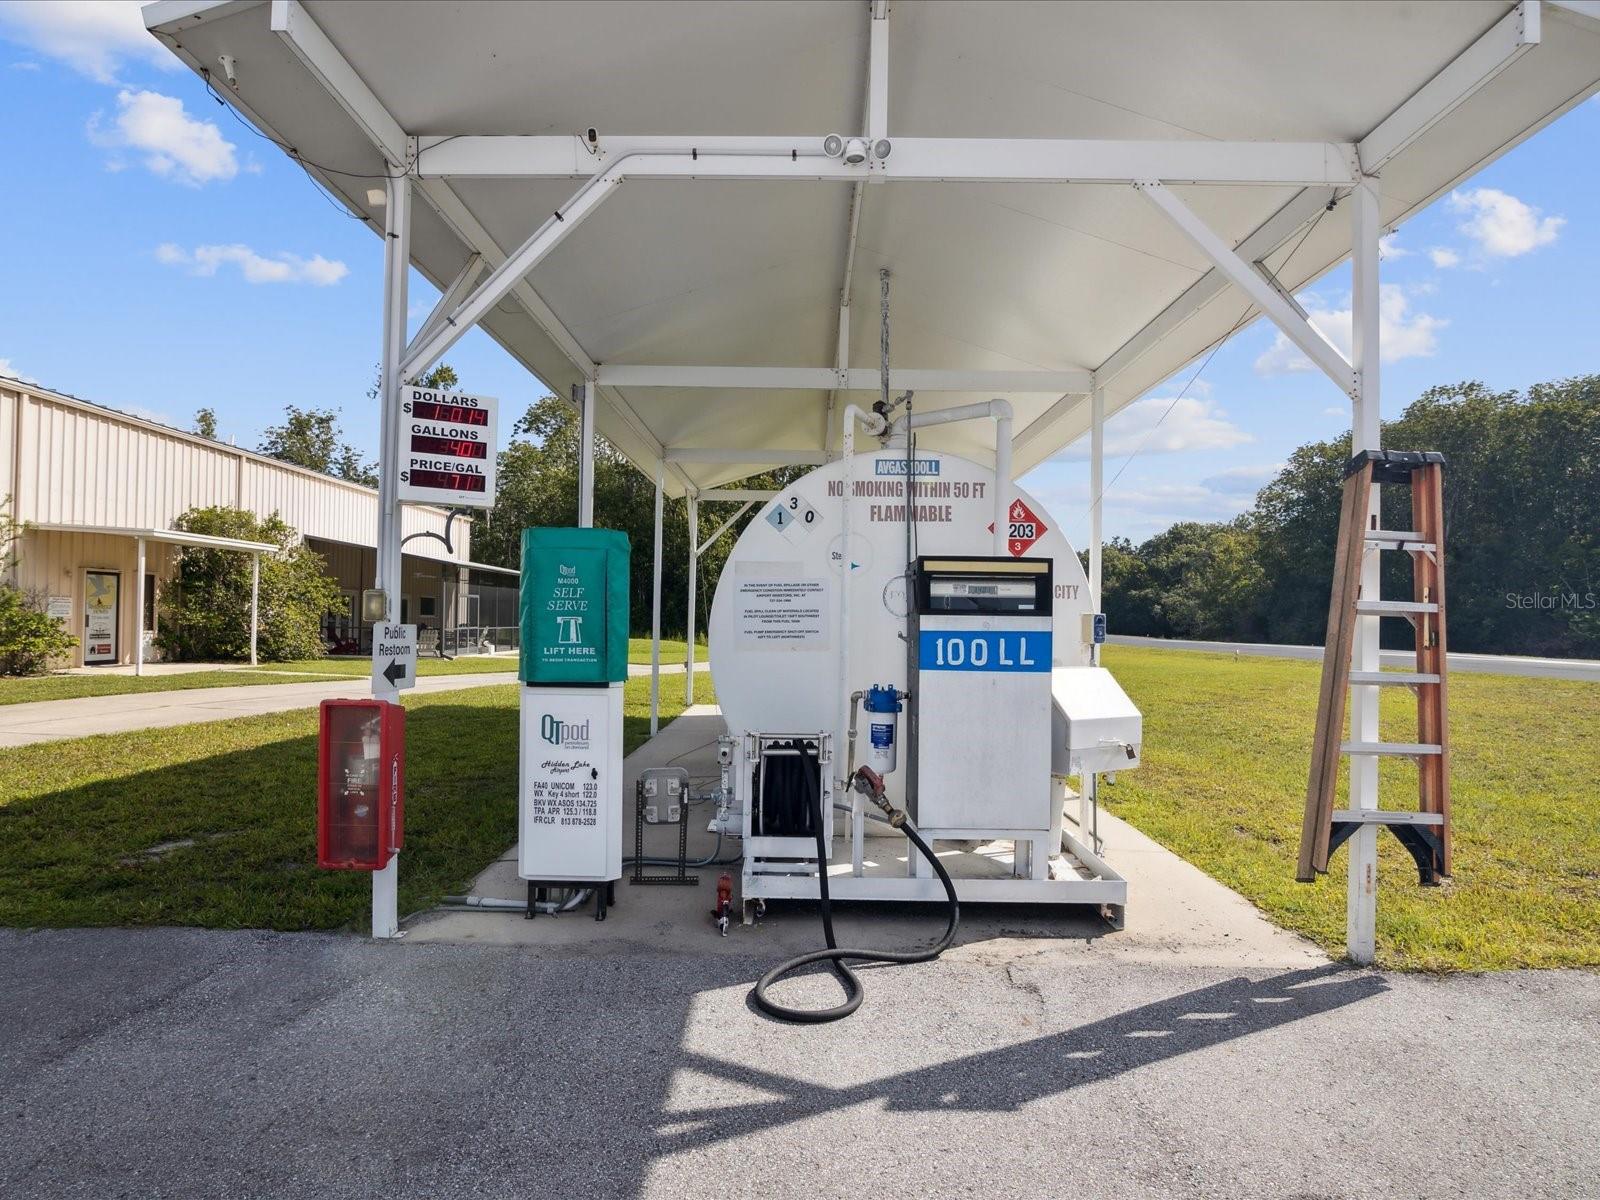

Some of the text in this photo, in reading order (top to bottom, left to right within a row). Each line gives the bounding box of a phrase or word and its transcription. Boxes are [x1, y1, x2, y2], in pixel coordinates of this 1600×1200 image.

[412, 391, 478, 407] DOLLARS
[403, 402, 412, 414] $
[411, 424, 478, 440] GALLONS
[410, 458, 482, 474] PRICE/GAL
[878, 461, 907, 475] AVGAS
[400, 471, 409, 483] $
[828, 480, 843, 498] NO
[852, 480, 903, 498] MOKING
[954, 480, 969, 498] 50
[973, 480, 986, 498] FT
[790, 497, 798, 510] 3
[778, 512, 783, 524] 1
[1014, 542, 1021, 550] 3
[553, 588, 584, 597] SELF
[547, 600, 588, 611] SERVE
[384, 625, 406, 639] Public
[379, 644, 410, 656] Restoom
[541, 714, 589, 745] QTpod
[541, 760, 590, 770] Hidden Lake
[548, 790, 558, 799] Key
